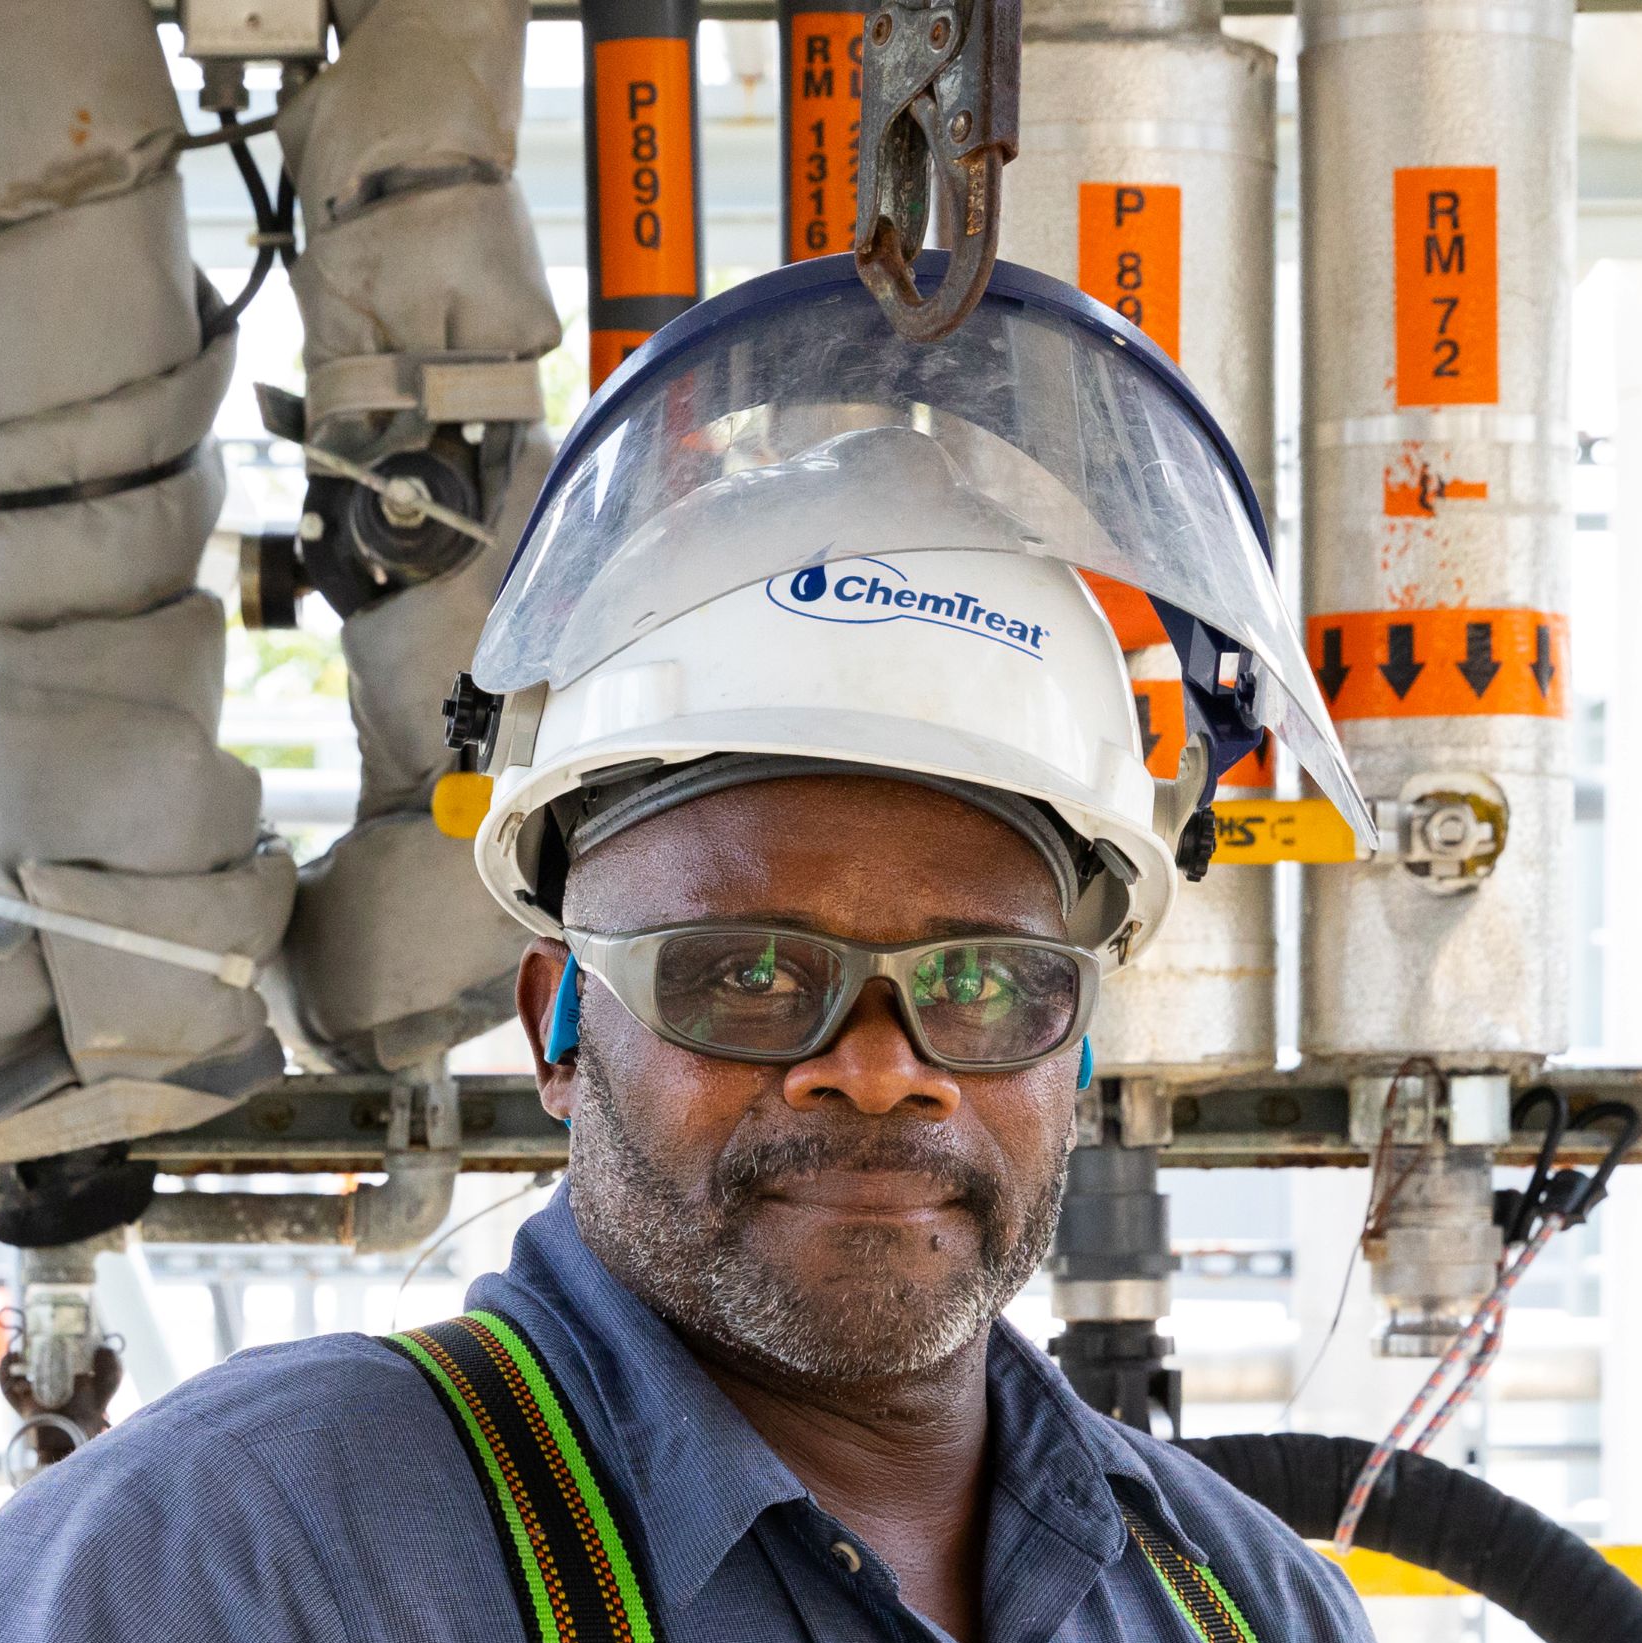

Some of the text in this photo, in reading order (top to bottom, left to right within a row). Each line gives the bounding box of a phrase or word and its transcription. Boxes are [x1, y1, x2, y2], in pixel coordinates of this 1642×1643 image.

[802, 35, 834, 251] RM 1316
[1114, 186, 1145, 228] P
[1425, 190, 1467, 380] RM 72
[833, 575, 1045, 650] ChemTreat
